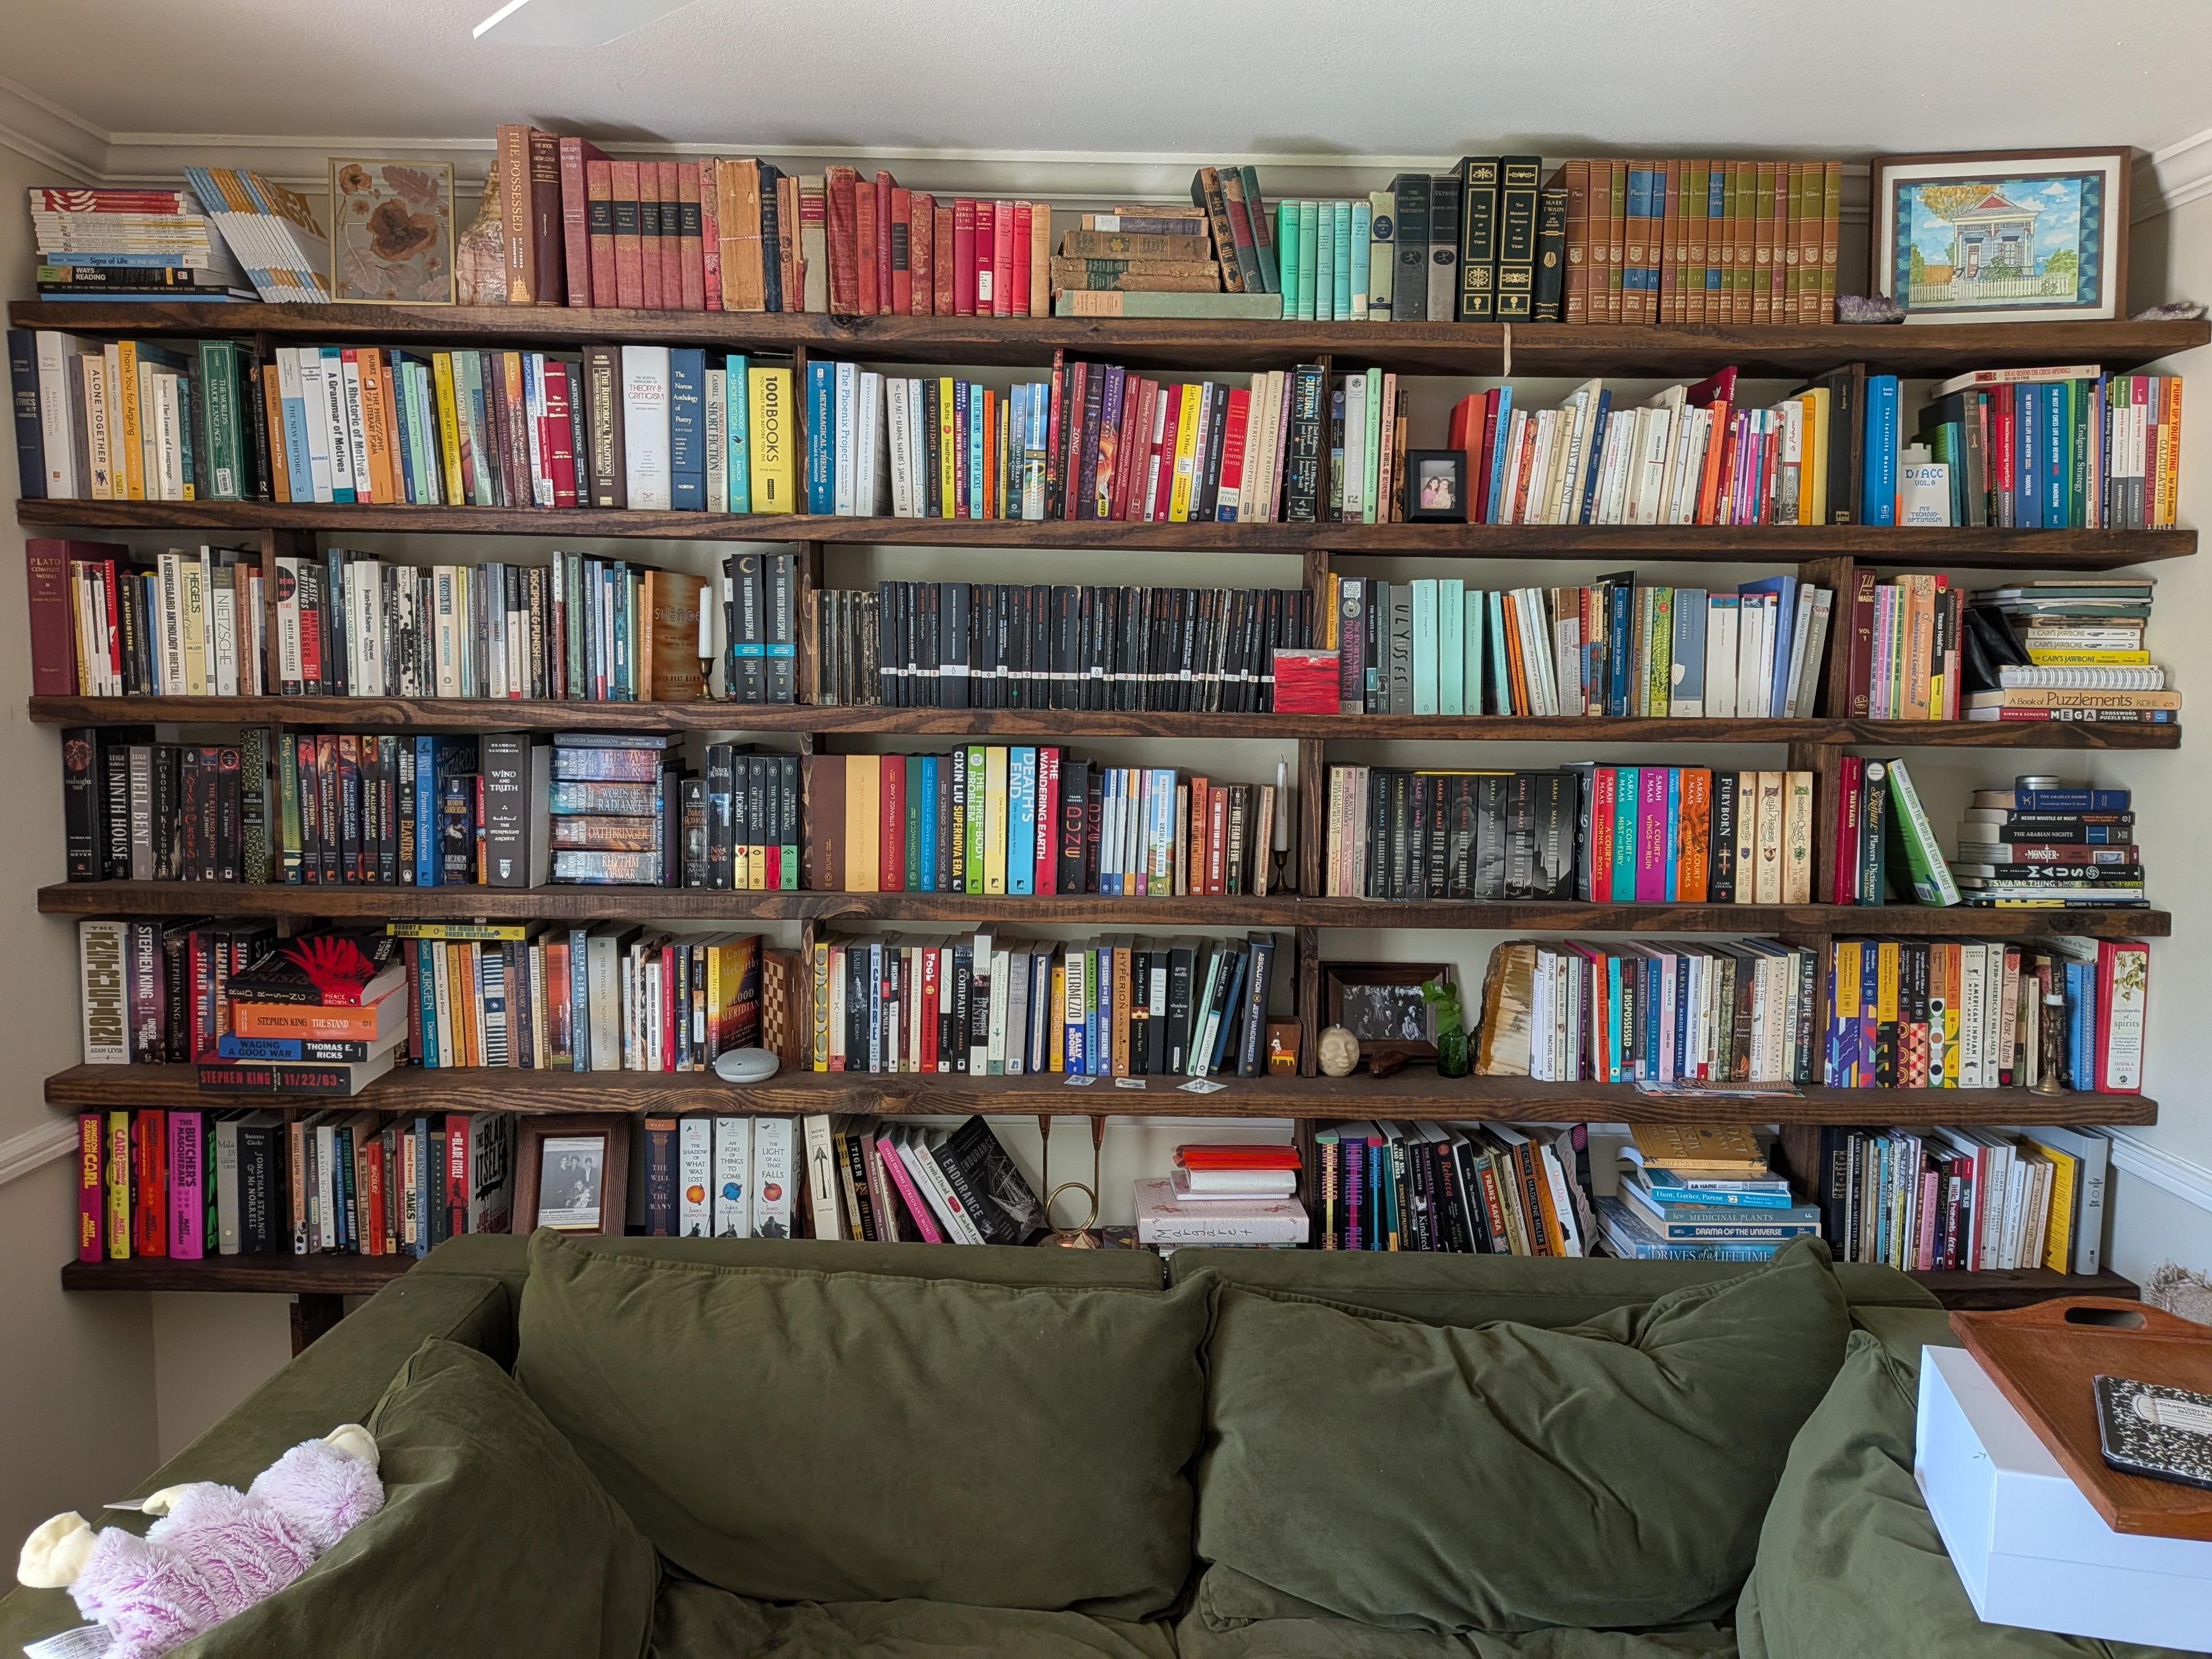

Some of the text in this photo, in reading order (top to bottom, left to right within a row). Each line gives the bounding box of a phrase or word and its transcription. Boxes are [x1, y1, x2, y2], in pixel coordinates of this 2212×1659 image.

[509, 132, 523, 232] THE POSSESSED
[90, 257, 107, 265] Signs
[124, 349, 133, 374] Thank
[368, 354, 377, 375] BURKE
[125, 375, 134, 391] You
[1303, 375, 1315, 420] CULTURAL
[92, 369, 106, 463] ALONE TOGETHER
[328, 380, 340, 425] Grammar
[348, 386, 359, 426] Rhetoric
[840, 367, 851, 462] The Phoenix Project
[2173, 403, 2180, 413] UP
[126, 406, 135, 436] Arguing
[333, 427, 341, 437] of
[353, 427, 360, 439] of
[708, 401, 719, 471] SHORT FICTION
[2171, 415, 2179, 435] YOUR
[292, 433, 301, 475] RHETORIC
[334, 439, 345, 473] Motives
[1071, 426, 1081, 455] ZONG!
[2169, 438, 2178, 472] RATING
[354, 440, 365, 478] Motives
[2074, 424, 2086, 494] Endgame Strategy
[2157, 439, 2167, 505] CALCULATION
[163, 563, 175, 610] KIERKEGAARD
[190, 572, 201, 613] HEGEL'S
[300, 568, 309, 609] WRITINGS
[308, 577, 319, 603] BASIC
[655, 604, 701, 622] silence
[743, 577, 754, 640] THE NORTON SHAKESPEARE
[124, 606, 133, 651] AUGUSTINE
[166, 611, 178, 650] ANTHOLOGY
[217, 595, 232, 666] NIETZSCHE
[301, 612, 311, 658] HEIDEGGER
[309, 612, 319, 643] MARTIN
[169, 652, 180, 680] BRETALL
[1342, 620, 1354, 698] DOROTHY PARKER
[2042, 655, 2095, 664] CAIN'S JAWBONE
[2047, 692, 2132, 706] Puzzlements
[2050, 709, 2096, 721] MEGA
[601, 787, 640, 799] WORDS OF
[968, 771, 976, 822] PROBLEM
[1009, 762, 1022, 799] END
[1021, 753, 1035, 823] DEATH'S
[108, 772, 128, 860] NINTH HOUSE
[132, 772, 150, 847] HELL BENT
[598, 799, 644, 812] RADIANCE
[952, 751, 964, 877] CIXIN LIU SUPERNOVA ERA
[1036, 752, 1049, 860] WANDERING EARTH
[1232, 810, 1241, 824] WILL
[1721, 778, 1733, 837] FURYBORN
[588, 828, 649, 839] OATHBRINGER
[1065, 806, 1083, 858] DUNE
[1230, 841, 1240, 849] NO
[1231, 825, 1241, 840] FEAR
[603, 857, 639, 868] RHYTHM
[1230, 850, 1239, 862] EVIL
[1431, 831, 1445, 888] HEIR OF FIRE
[2025, 847, 2058, 863] MONSTER
[2027, 865, 2084, 878] MAUS
[138, 927, 153, 999] STEPHEN KING
[925, 953, 936, 982] FOOL
[1254, 952, 1264, 994] ABSOLUTION
[422, 968, 433, 1010] JURGEN
[957, 968, 967, 1020] COMPANY
[1067, 962, 1082, 1018] INTERMEZZO
[1118, 952, 1127, 1009] HYPERION
[327, 1019, 348, 1028] STAND
[972, 998, 982, 1036] PINTER
[1624, 995, 1632, 1047] DISPOSSESSED
[1804, 998, 1812, 1020] WIFE
[2114, 1020, 2140, 1029] spirits
[238, 1049, 265, 1057] GOOD
[268, 1049, 292, 1057] WAR
[240, 1040, 280, 1050] WAGING
[306, 1043, 339, 1051] THOMAS
[1074, 1031, 1082, 1059] SALLY
[200, 1071, 271, 1084] STEPHEN KING
[284, 1074, 337, 1087] 11/22/63
[84, 1154, 98, 1189] CARL
[177, 1127, 185, 1188] MASQUERADE
[185, 1127, 196, 1187] BUTCHER'S
[1522, 1150, 1531, 1176] CIRCE
[405, 1190, 415, 1220] JAMES
[1677, 1192, 1700, 1201] Gather,
[1702, 1193, 1723, 1202] Parent
[1418, 1215, 1431, 1250] Kindred
[1651, 1250, 1771, 1261] DRIVES LIFETIME
